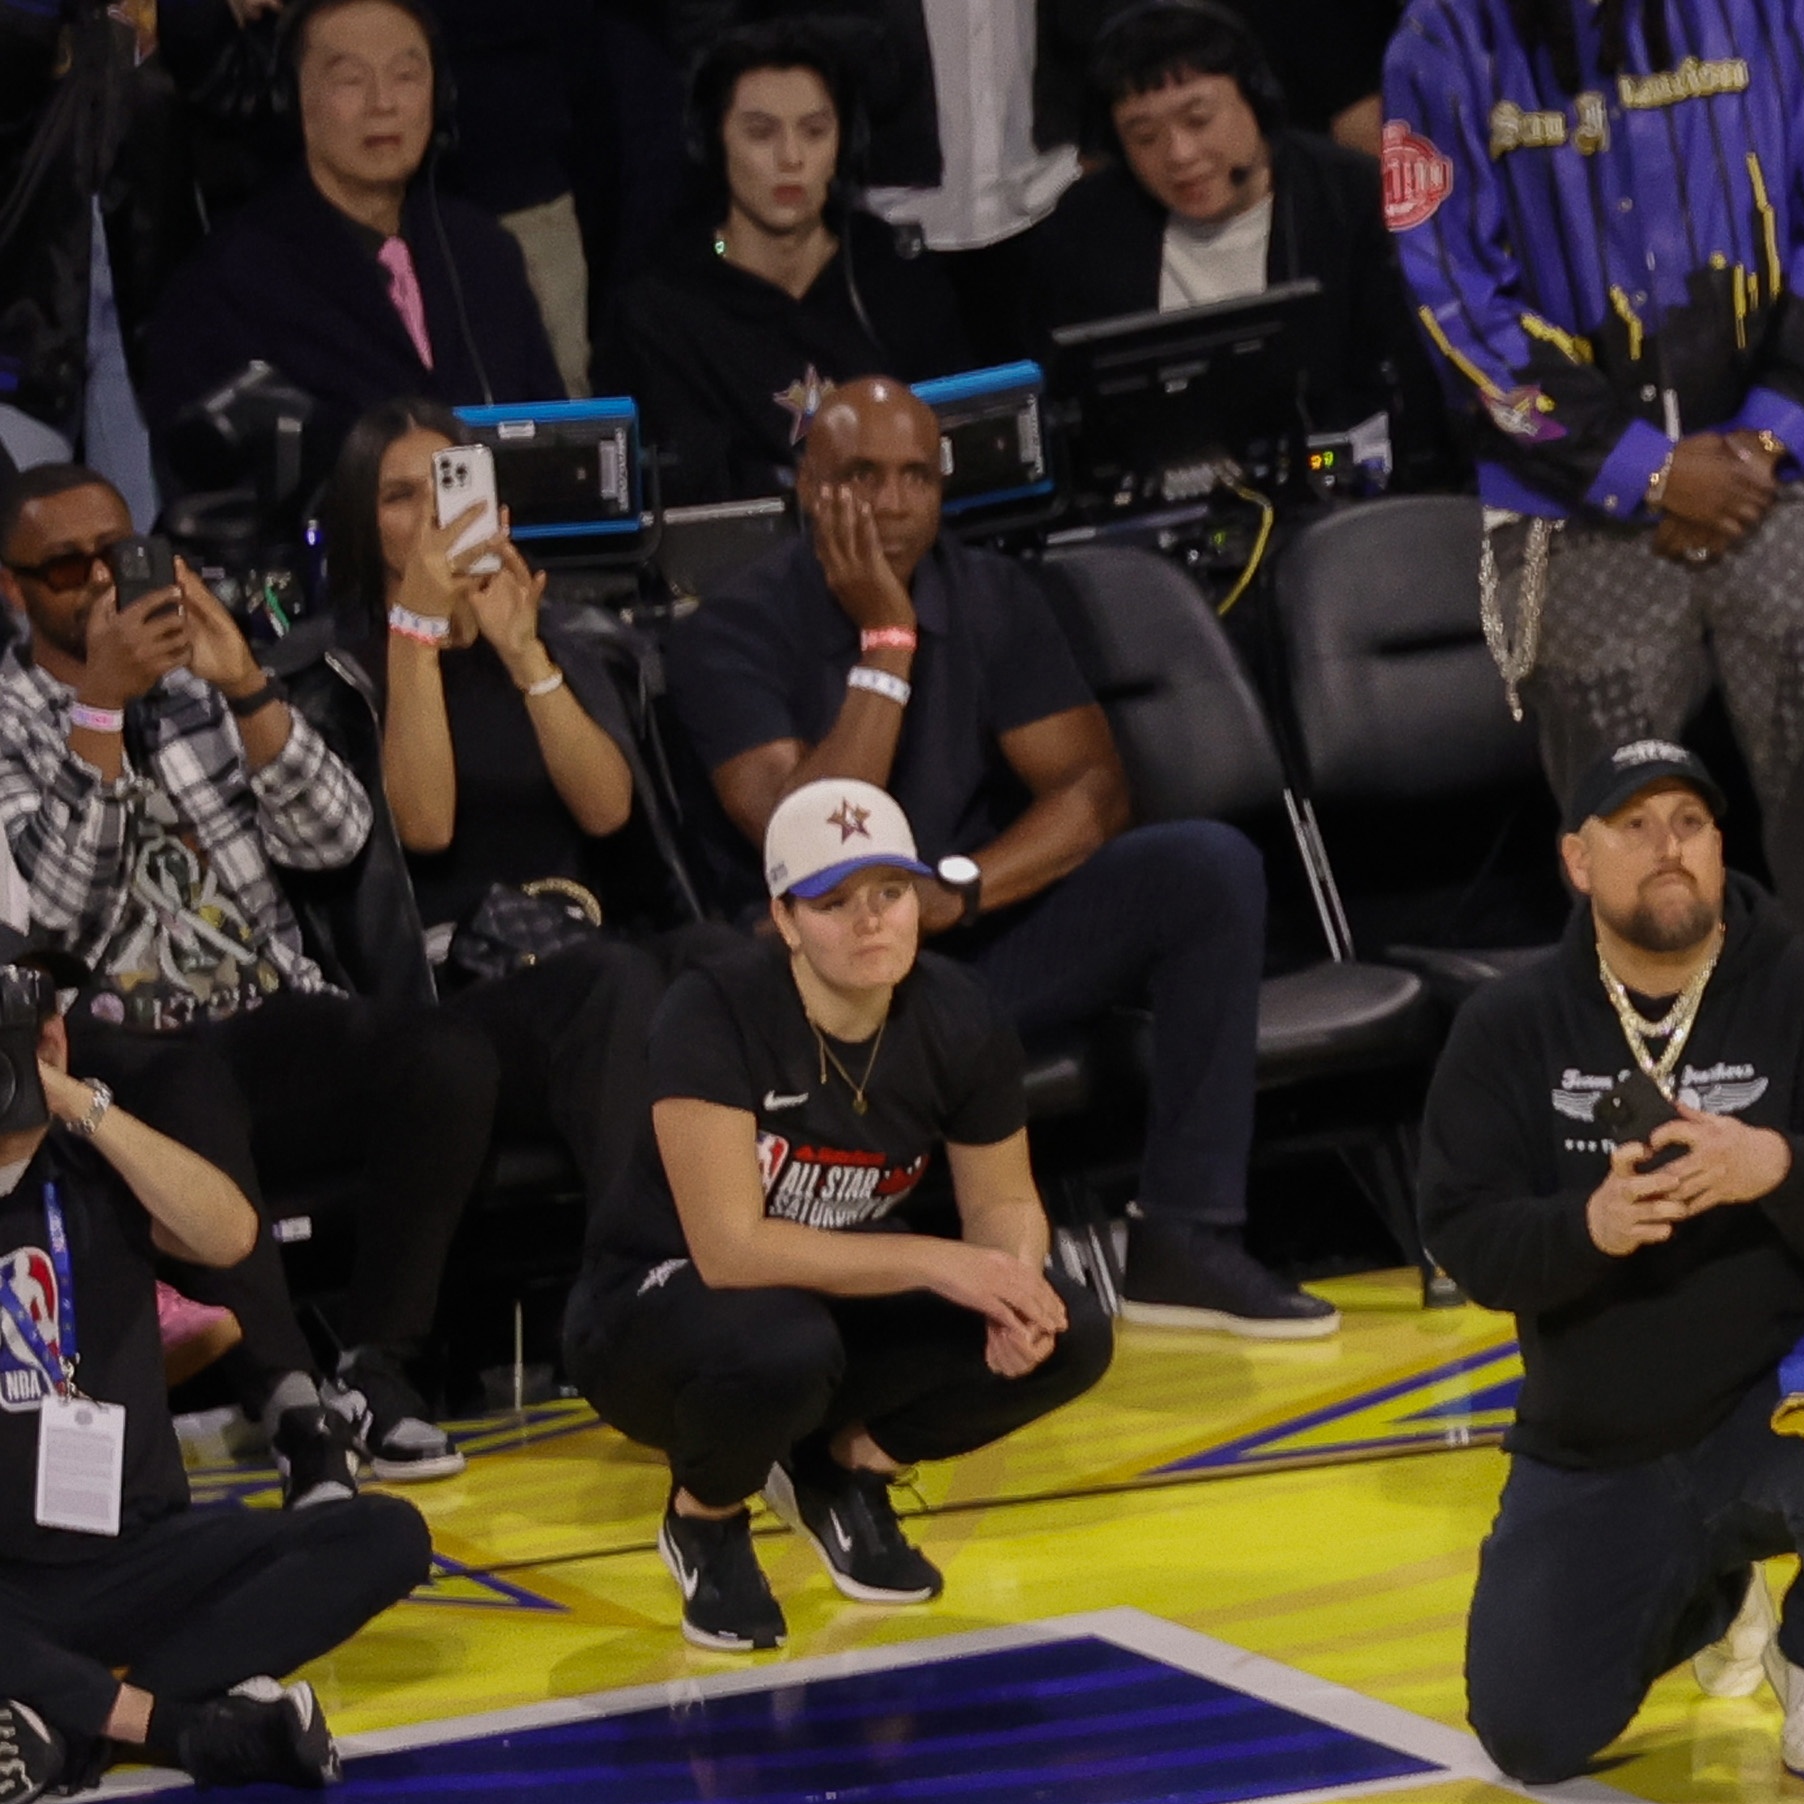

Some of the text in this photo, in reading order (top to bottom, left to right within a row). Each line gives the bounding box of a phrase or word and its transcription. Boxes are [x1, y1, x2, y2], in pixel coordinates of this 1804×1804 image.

[778, 1160, 881, 1200] ALL STAR
[5, 1370, 41, 1401] NBA
